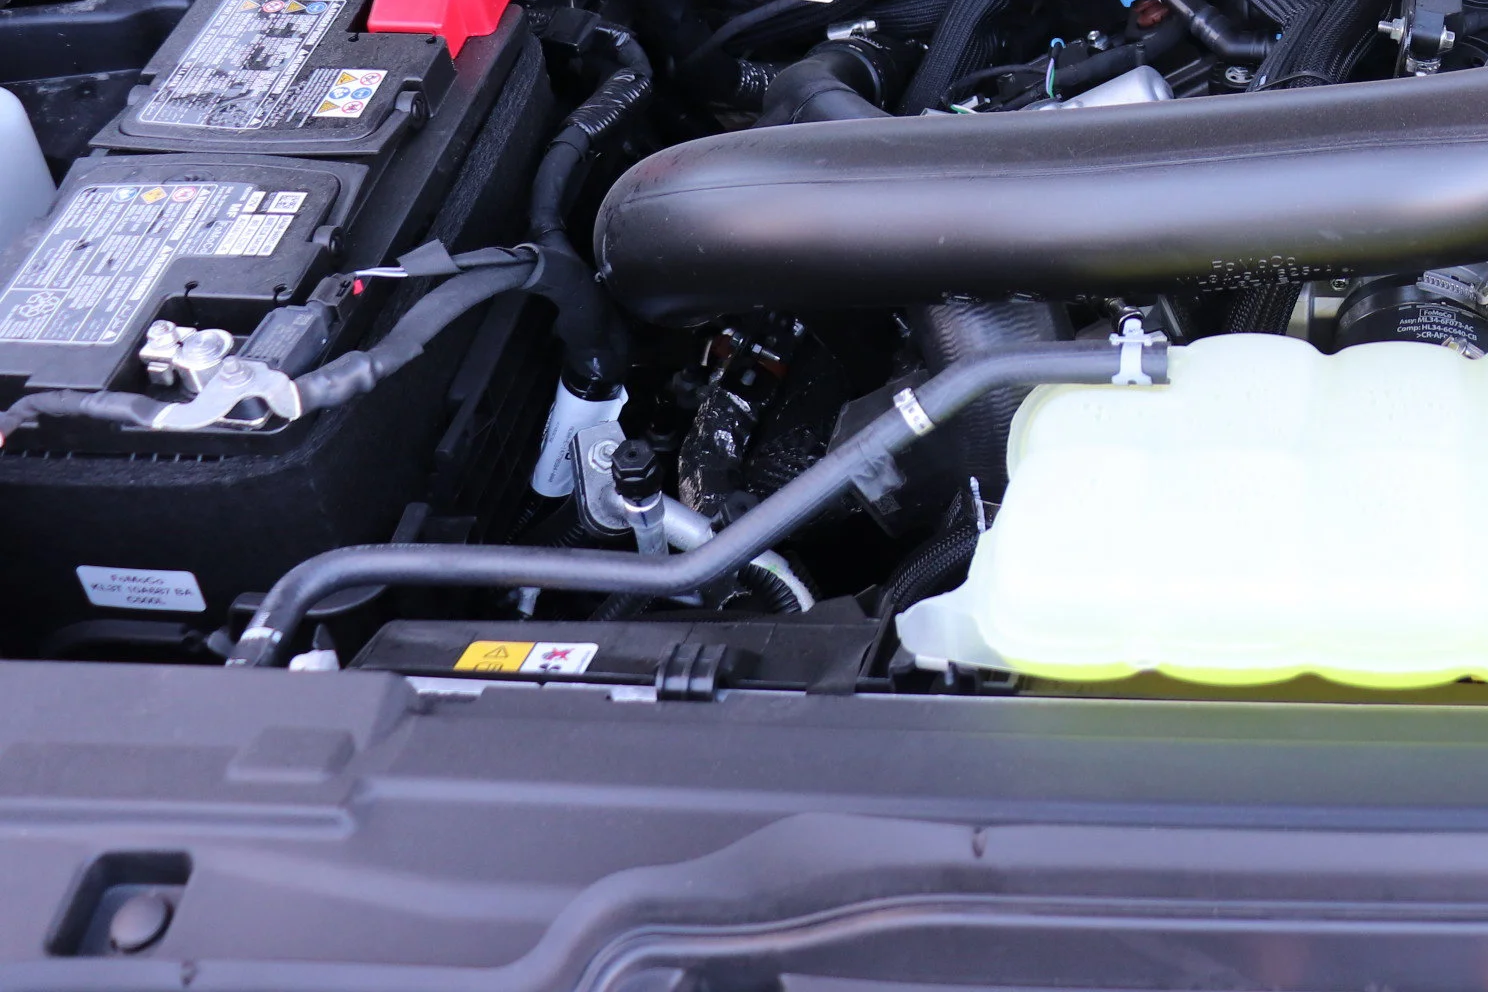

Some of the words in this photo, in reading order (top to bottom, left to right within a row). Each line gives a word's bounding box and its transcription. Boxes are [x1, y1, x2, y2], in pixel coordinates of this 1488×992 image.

[200, 221, 229, 254] FoMoCo
[1423, 309, 1452, 318] FoMoCo
[1396, 325, 1421, 333] Comp:
[1417, 317, 1475, 332] ML34-6F073-AC
